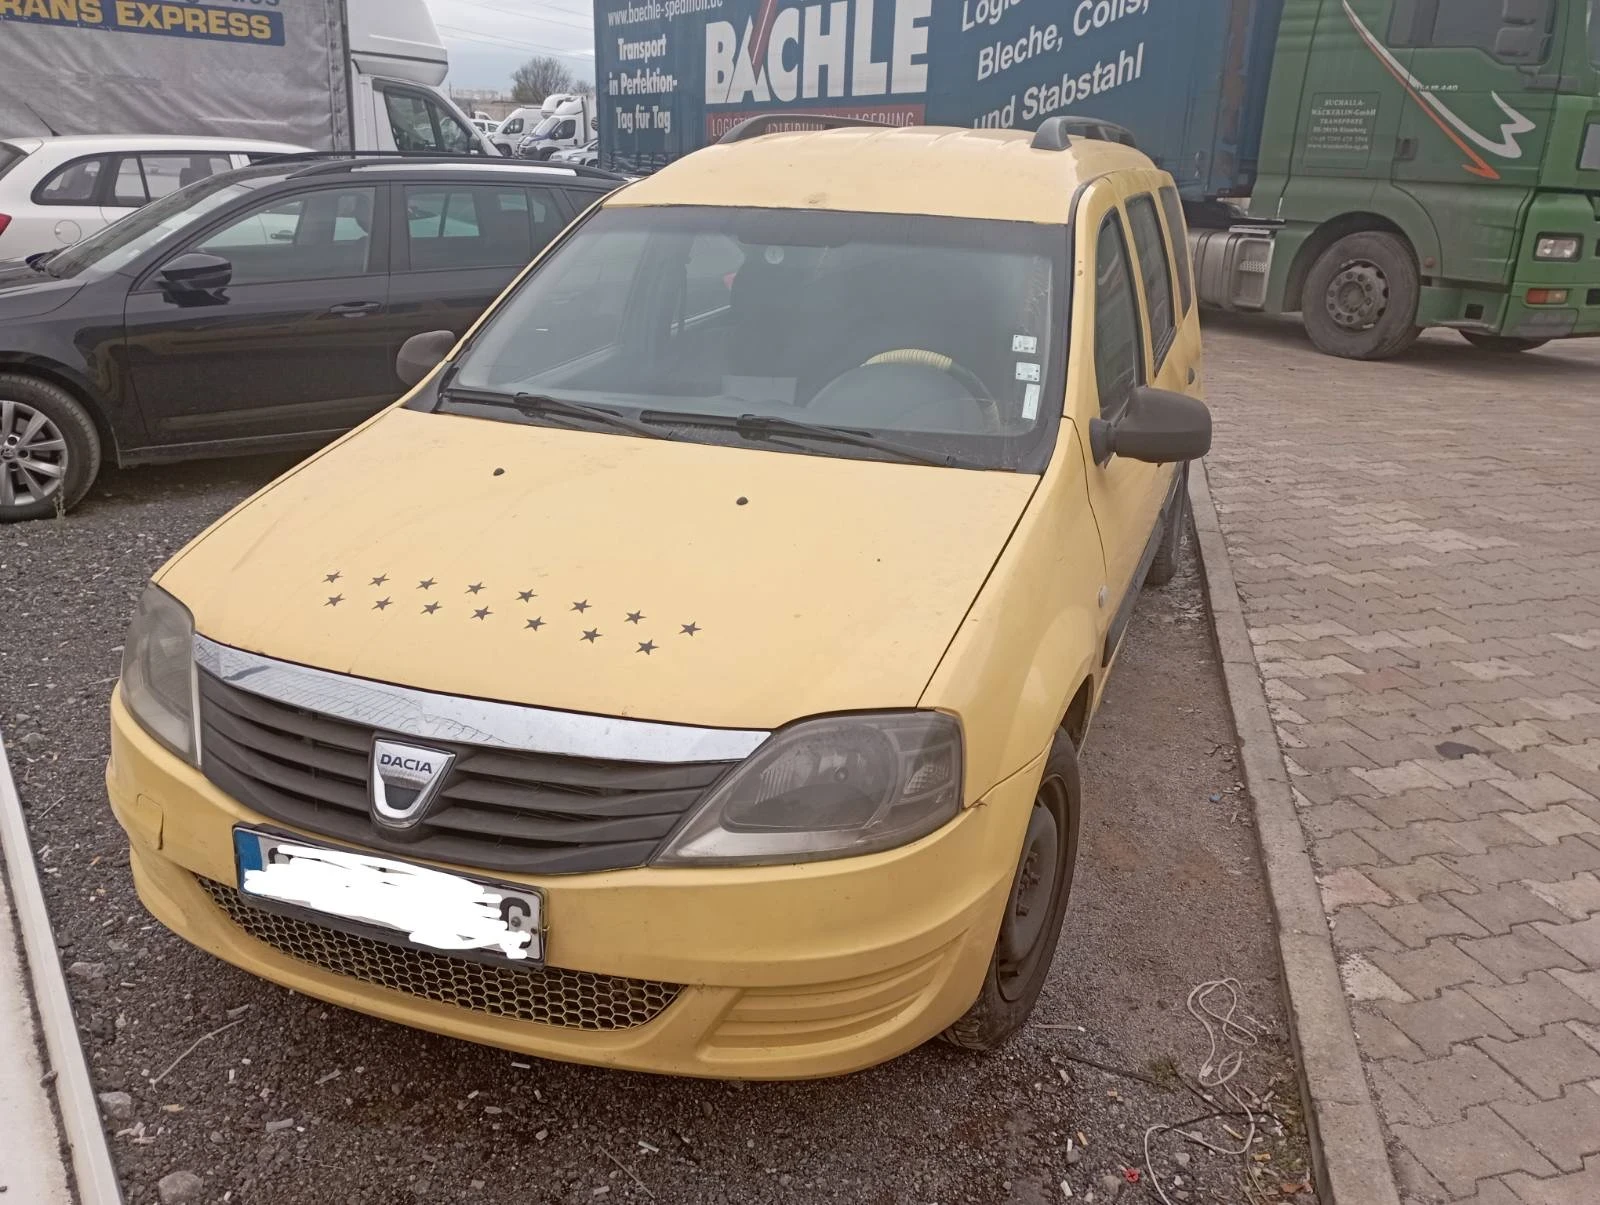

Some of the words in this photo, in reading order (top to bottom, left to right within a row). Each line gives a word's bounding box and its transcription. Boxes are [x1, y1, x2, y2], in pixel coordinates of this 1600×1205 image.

[116, 1, 272, 40] EXPRESS
[962, 0, 1021, 32] Log
[618, 33, 667, 63] Transport
[977, 24, 1063, 81] Bleche,
[609, 71, 618, 96] in
[621, 67, 678, 95] Perfektion-
[974, 95, 1016, 129] und
[1022, 42, 1144, 121] Stabstahl
[616, 106, 633, 134] Tag
[635, 104, 650, 128] für
[652, 105, 671, 134] Tag
[712, 116, 747, 137] LOGIS
[380, 753, 432, 774] DACIA
